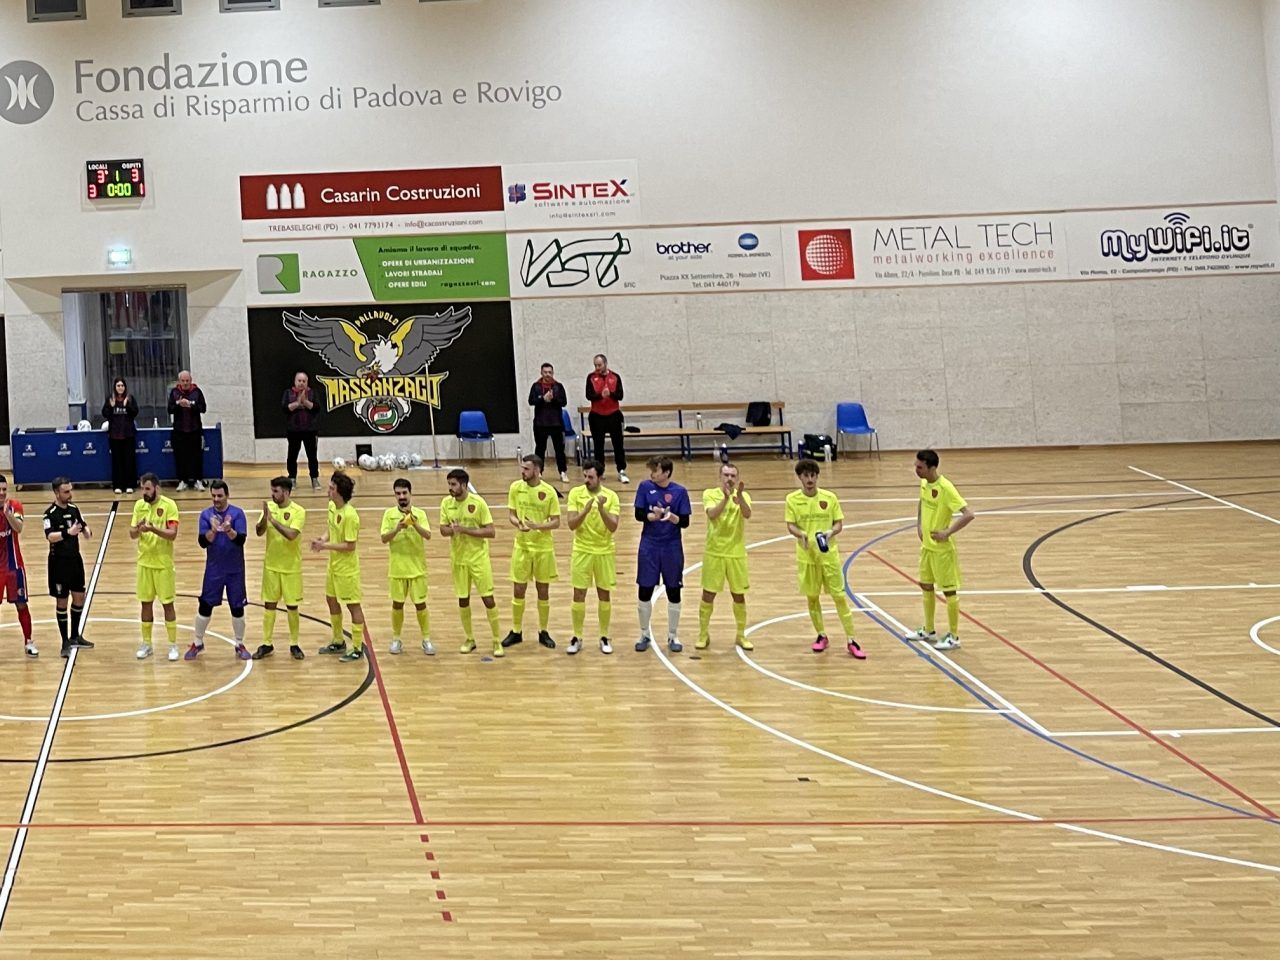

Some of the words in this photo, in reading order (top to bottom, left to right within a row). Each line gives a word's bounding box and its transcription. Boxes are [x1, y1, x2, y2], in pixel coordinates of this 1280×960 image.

[75, 52, 308, 94] Fondazione
[76, 98, 145, 123] Cassa
[153, 93, 176, 119] di
[186, 90, 310, 122] Risparmio
[320, 86, 342, 112] di
[353, 82, 444, 108] Padova
[452, 88, 467, 105] e
[477, 79, 563, 109] Rovigo
[122, 162, 141, 170] OSPITI
[131, 168, 139, 182] 3
[89, 183, 97, 198] 3
[107, 183, 132, 197] 0:00
[140, 182, 144, 195] 1
[320, 188, 381, 204] Casarin
[386, 183, 481, 202] Costruzioni
[532, 179, 630, 201] SINTEX
[268, 223, 322, 232] TREBASELEGHE
[323, 223, 339, 231] (PD)
[349, 222, 361, 230] 041
[873, 225, 971, 251] METAL
[977, 221, 1053, 248] TECH
[656, 241, 712, 255] brother
[873, 251, 973, 264] metalworking
[979, 248, 1055, 261] excellence
[413, 258, 475, 266] URBANIZZAZIONE
[302, 268, 359, 279] RAGAZZO
[385, 270, 410, 278] LAVORI
[411, 269, 443, 277] STRADALI
[355, 310, 401, 328] PALLAVOLO
[322, 375, 444, 409] MASSANZAGO
